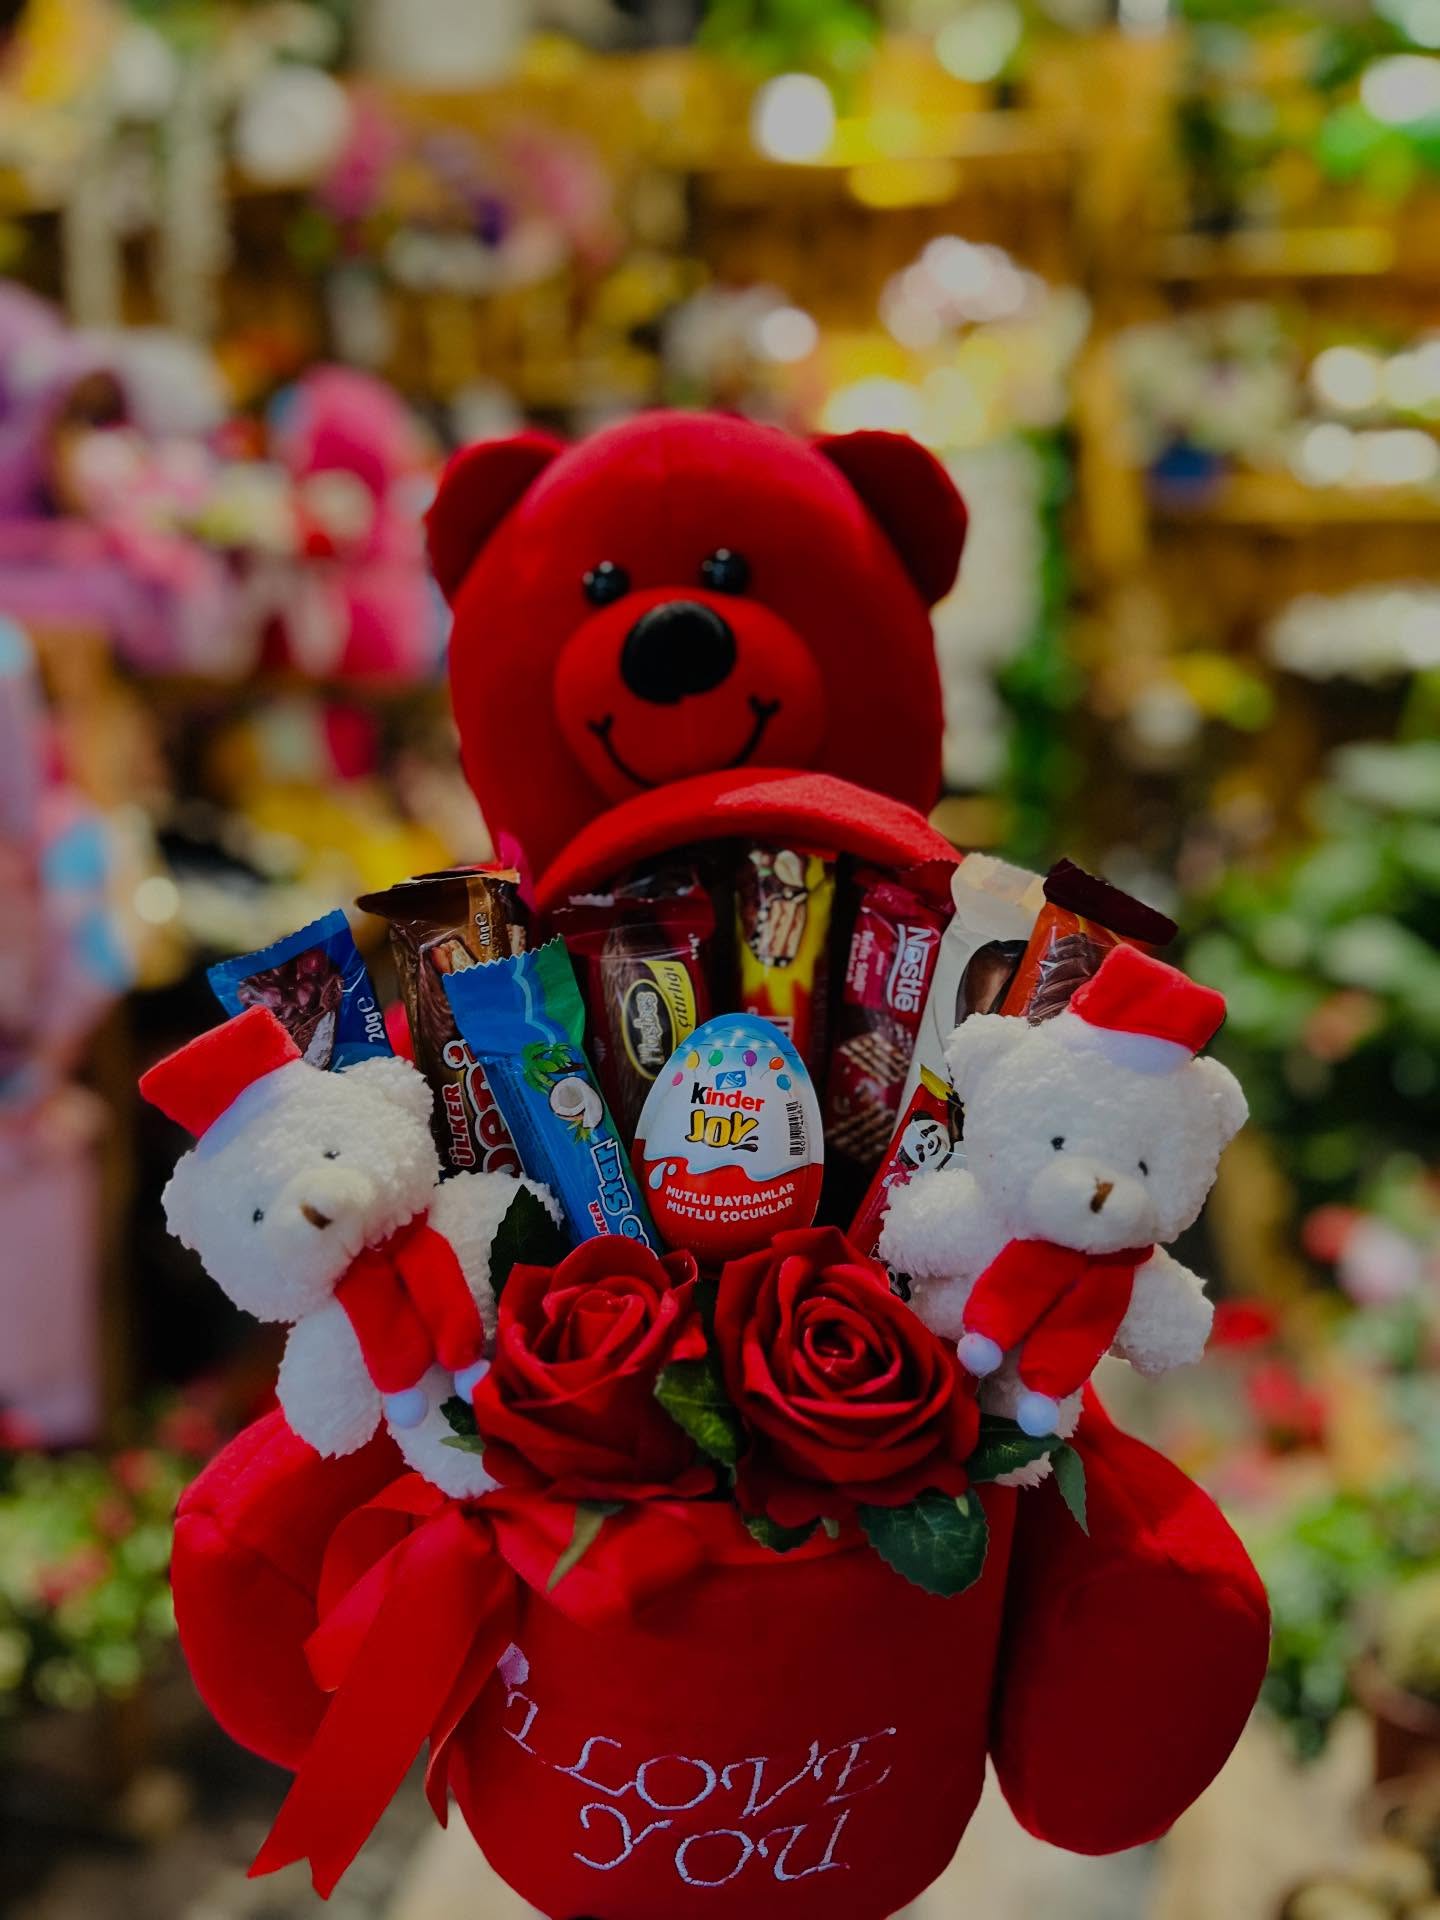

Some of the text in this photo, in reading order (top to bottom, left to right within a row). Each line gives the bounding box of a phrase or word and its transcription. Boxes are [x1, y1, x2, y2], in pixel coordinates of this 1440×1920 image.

[691, 1082, 765, 1112] Kinder
[442, 1083, 476, 1167] ÜLKER
[666, 1183, 796, 1207] MUTLU BAYRAMLAR
[666, 1197, 793, 1222] MUTLU ÇOCUKLAR
[588, 1199, 612, 1235] KER
[554, 1726, 897, 1820] LOVE
[573, 1803, 852, 1888] YOU
